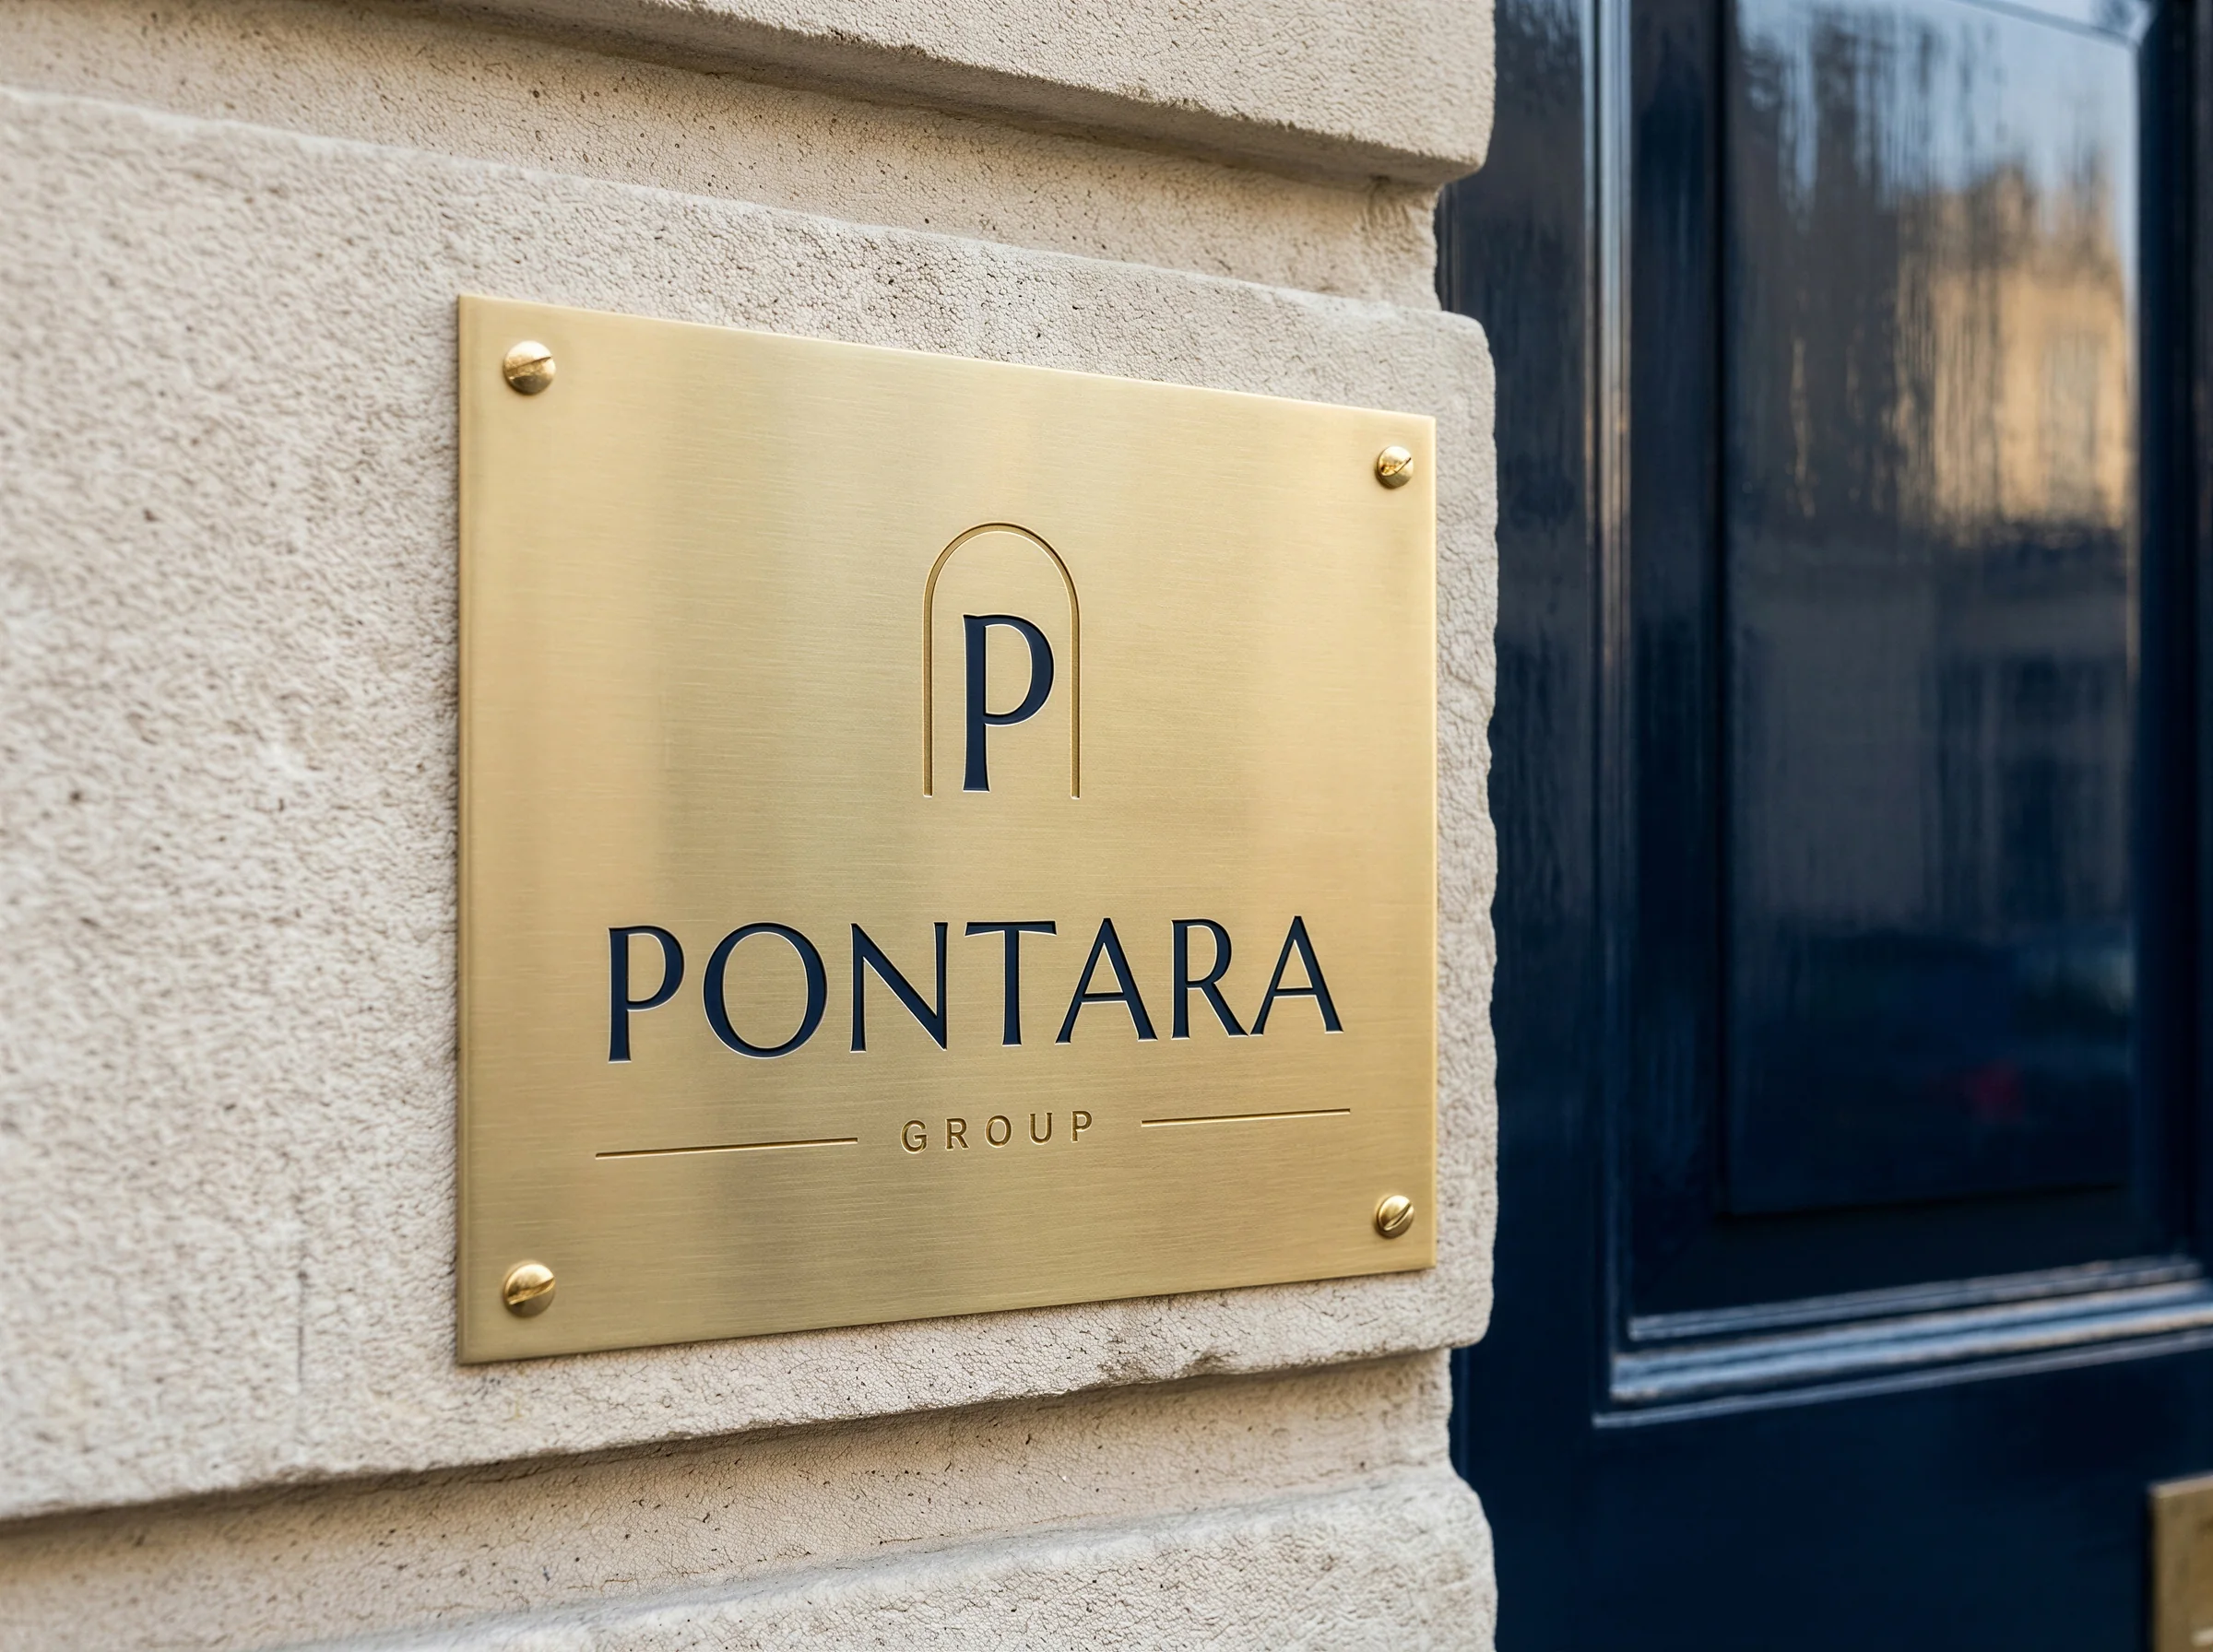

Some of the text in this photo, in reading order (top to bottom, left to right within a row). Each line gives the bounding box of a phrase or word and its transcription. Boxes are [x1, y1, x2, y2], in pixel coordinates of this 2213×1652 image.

[963, 614, 1055, 792] P
[608, 915, 1343, 1062] PONTARA
[901, 1110, 1093, 1153] GROUP
